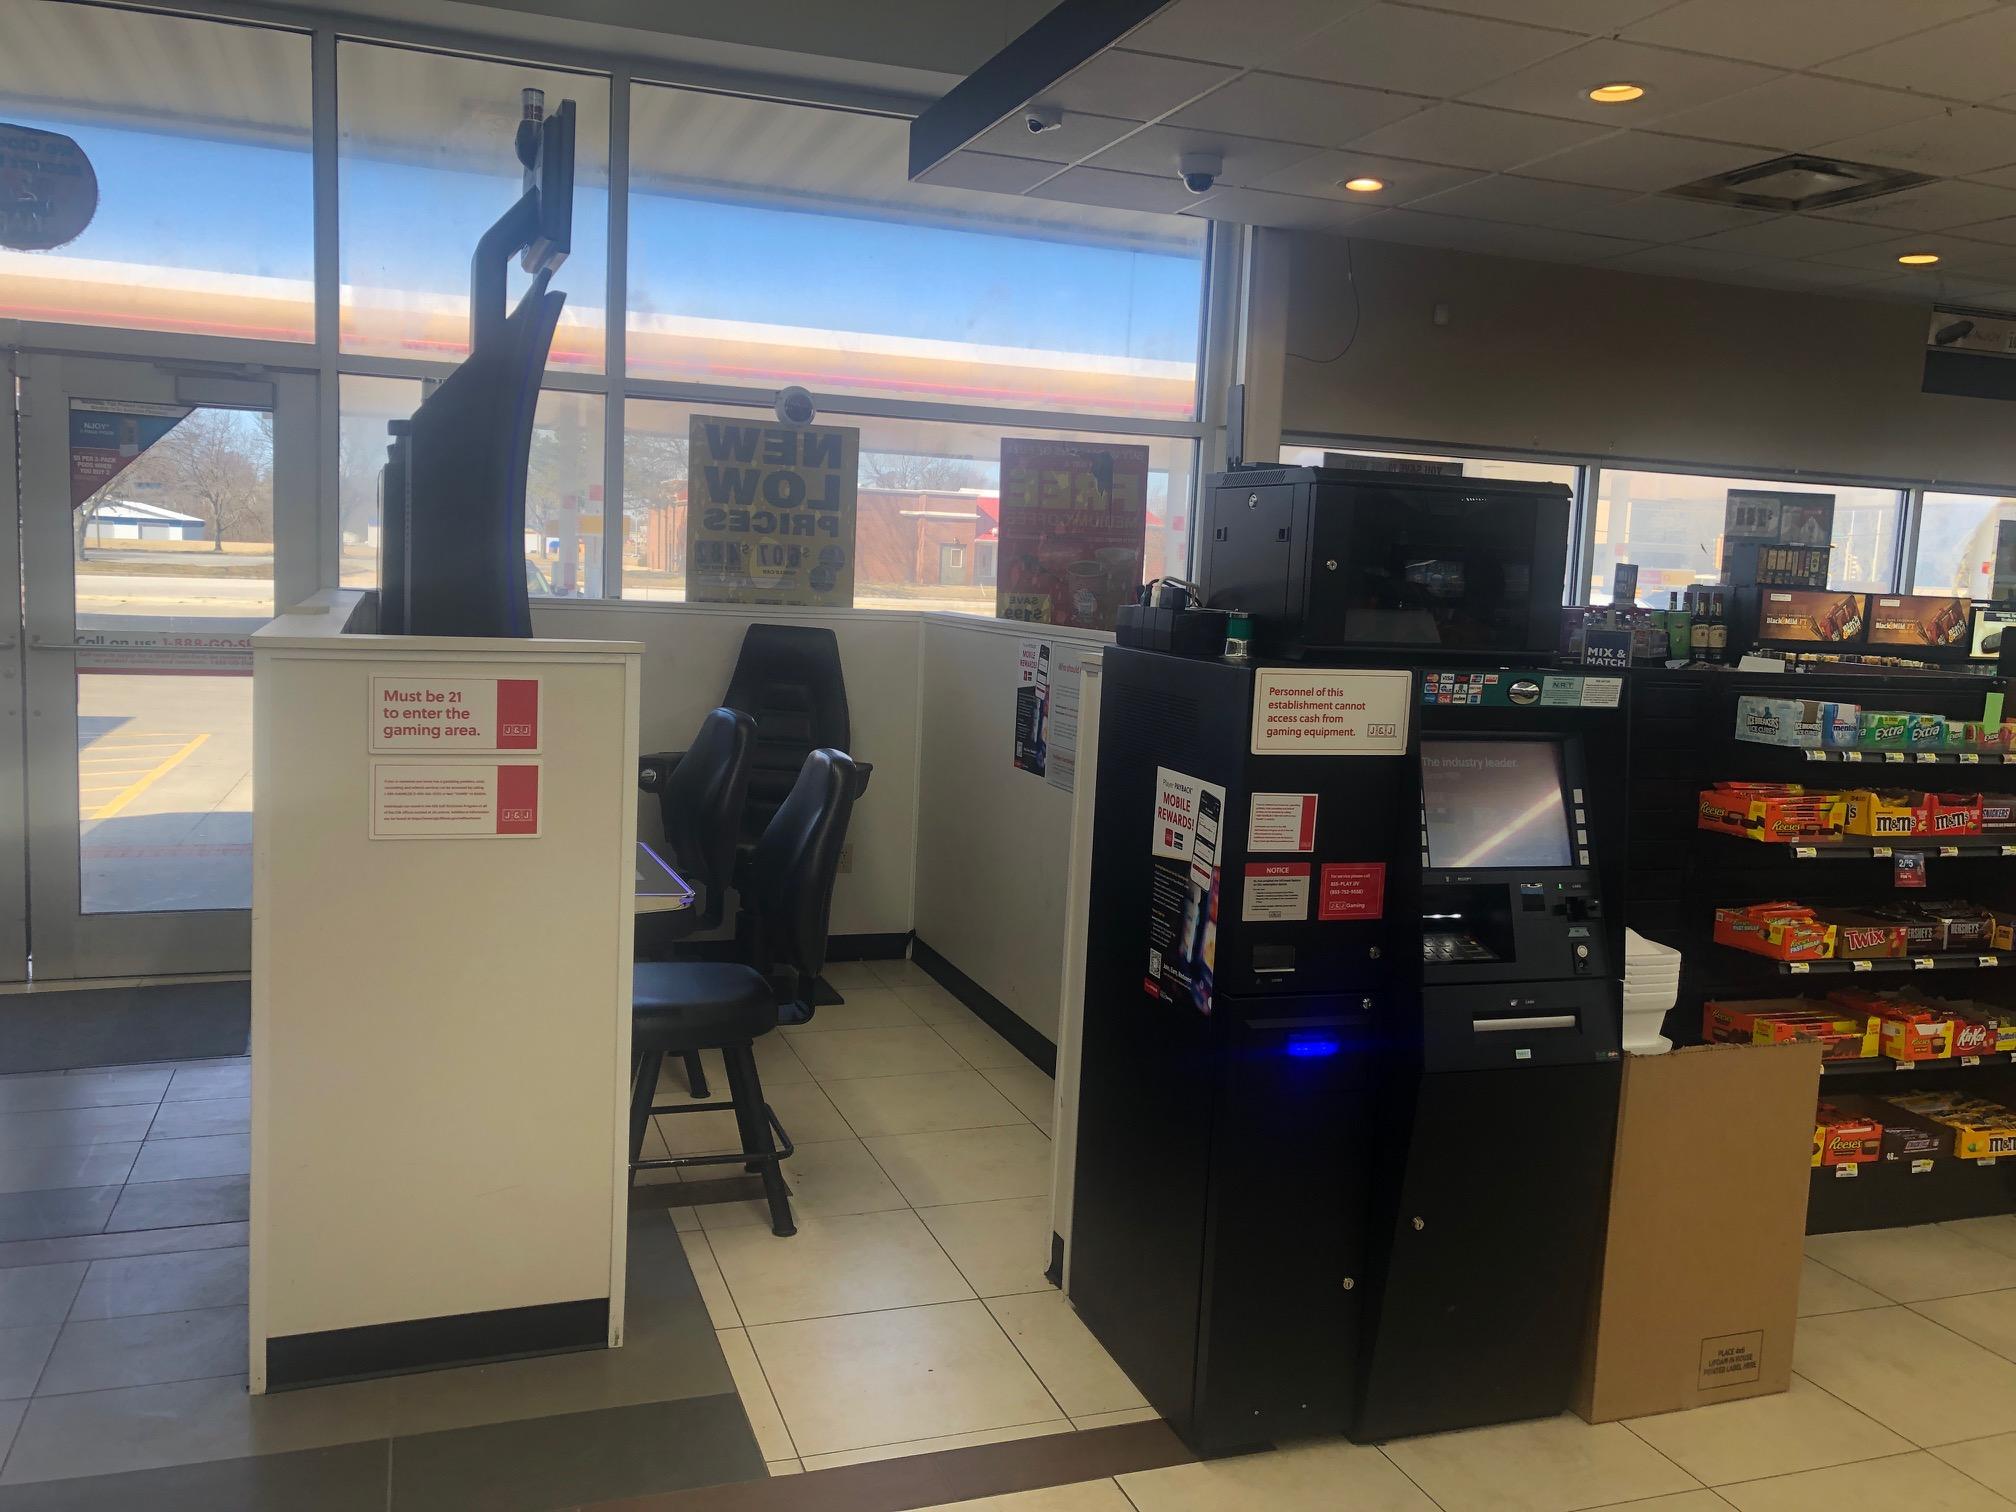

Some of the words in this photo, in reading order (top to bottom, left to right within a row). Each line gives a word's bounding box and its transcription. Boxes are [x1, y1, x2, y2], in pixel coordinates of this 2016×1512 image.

[1587, 647, 1613, 658] MIX
[1616, 649, 1626, 659] &
[1586, 657, 1626, 667] MATCH
[384, 690, 422, 703] Must
[425, 690, 445, 703] be
[448, 691, 462, 703] 21
[1269, 687, 1314, 697] Personnel
[1316, 687, 1327, 697] of
[1327, 688, 1344, 697] this
[1268, 700, 1333, 711] establishment
[1335, 702, 1366, 711] cannot
[383, 707, 399, 719] to
[402, 708, 443, 720] enter
[446, 708, 471, 720] the
[1267, 715, 1297, 723] access
[1299, 714, 1320, 723] cash
[1322, 714, 1344, 723] from
[383, 724, 441, 739] gaming
[444, 725, 481, 736] area.
[1266, 727, 1301, 738] gaming
[1304, 728, 1356, 738] equipment.
[1875, 725, 1904, 741] Extra
[1912, 725, 1940, 741] Extra
[1422, 756, 1440, 767] The
[1442, 756, 1484, 770] industry
[1163, 791, 1191, 813] MOBILE
[1157, 806, 1195, 831] REWARDS!
[1829, 1136, 1863, 1150] Reese's
